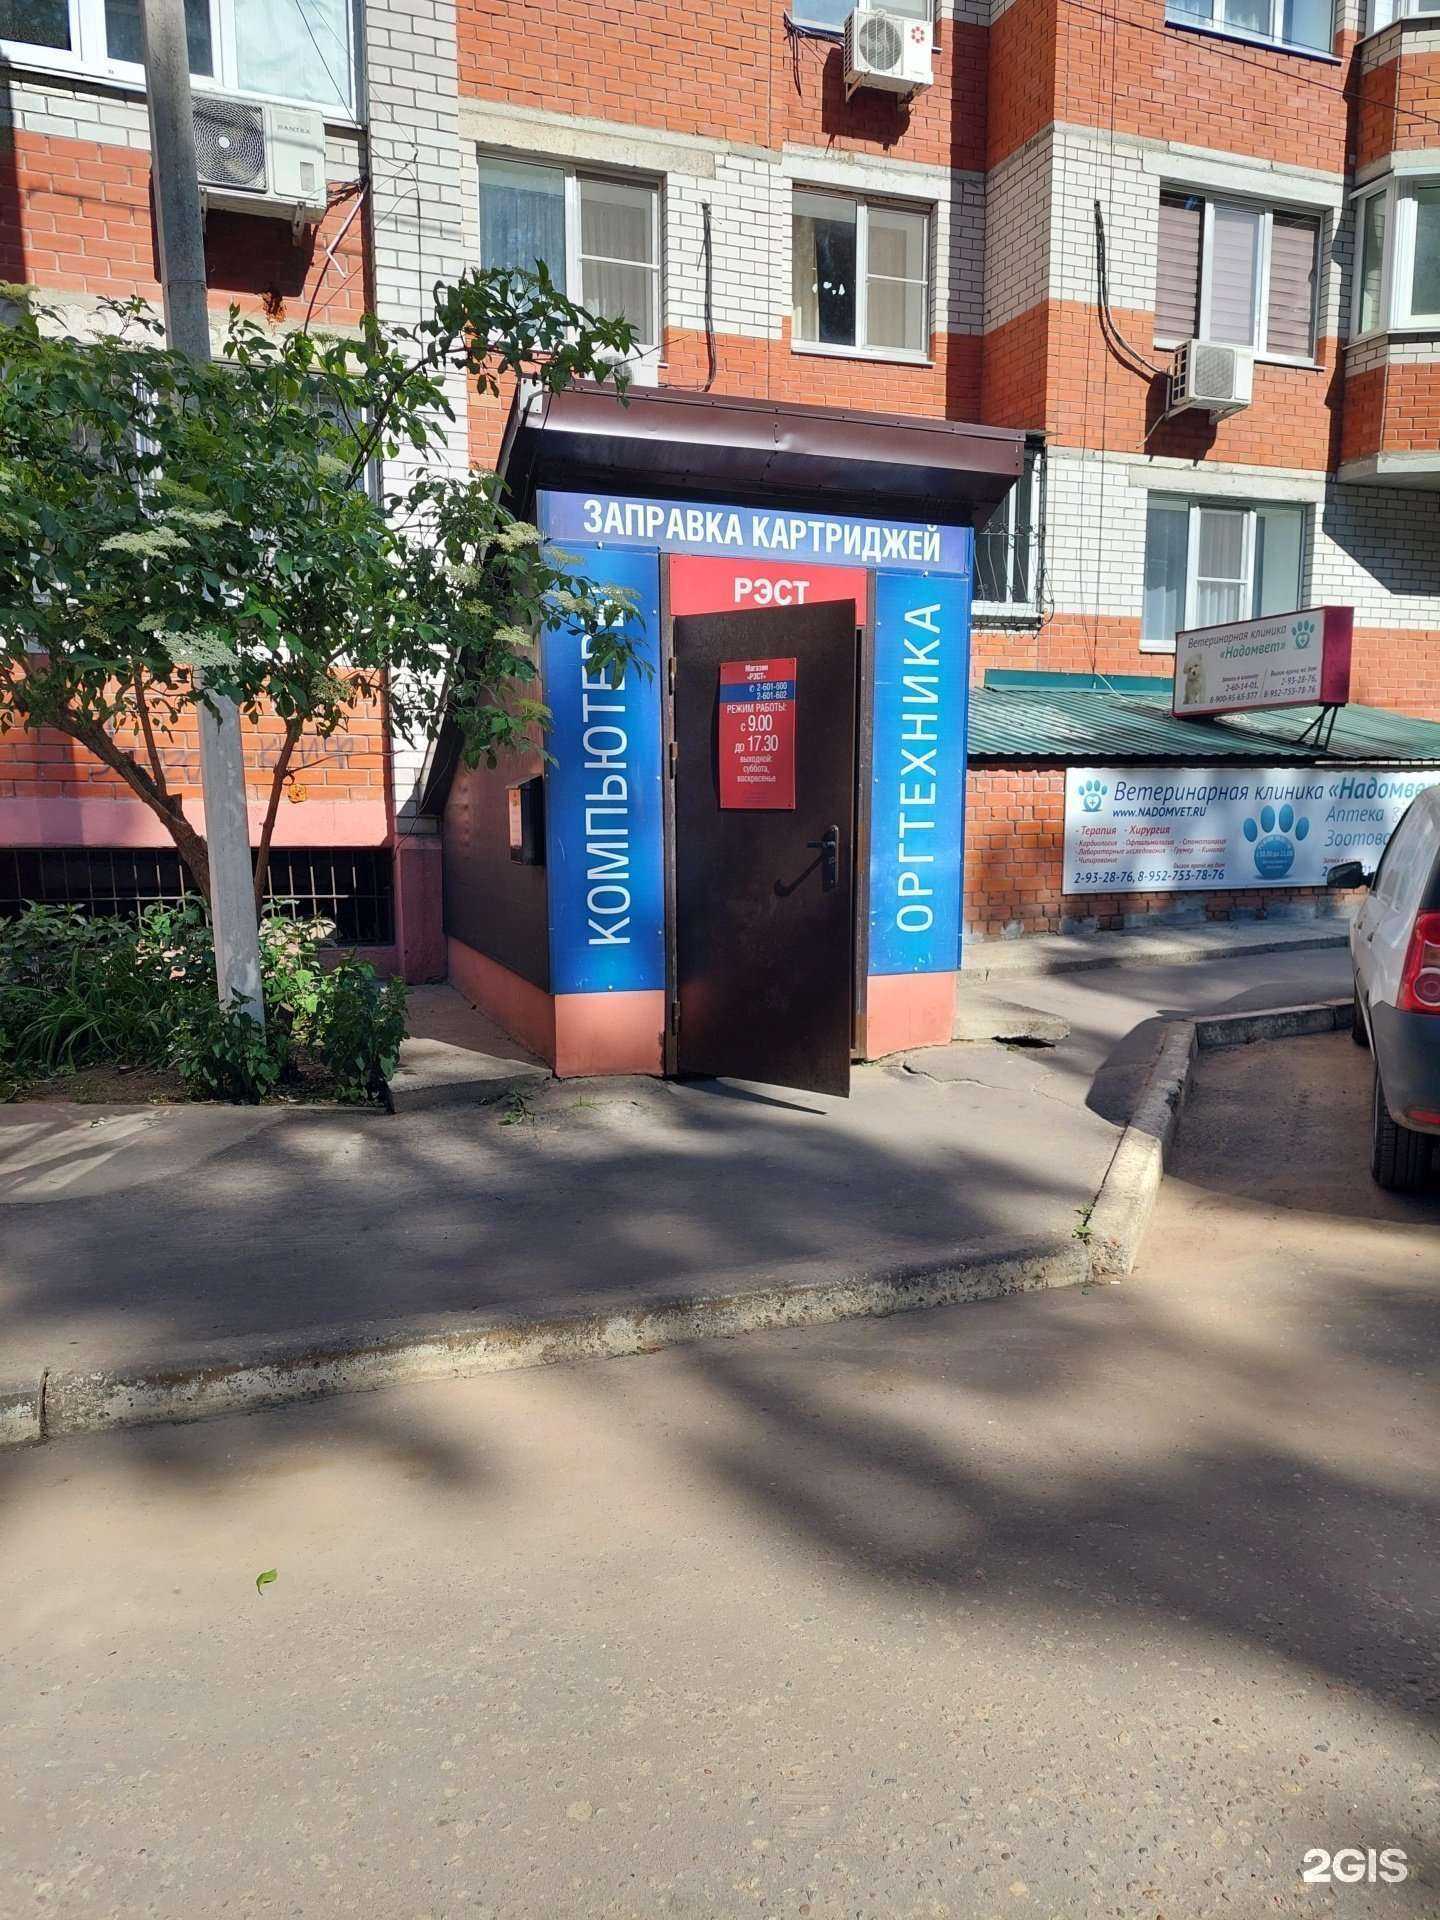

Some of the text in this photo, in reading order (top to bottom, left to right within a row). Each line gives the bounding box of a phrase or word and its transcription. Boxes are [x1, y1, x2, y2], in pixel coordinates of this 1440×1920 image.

[583, 499, 941, 564] ЗАПРАВКА КАРТРИДЖЕЙ
[734, 577, 811, 606] РЭСТ
[1187, 624, 1287, 649] Ветеринарная клиника
[1220, 641, 1286, 660] «Надомвет»
[744, 664, 769, 673] Магазин
[727, 704, 754, 714] РЕЖИМ
[740, 714, 773, 732] с 9.00
[734, 734, 779, 754] до 17.30
[742, 764, 770, 774] суббота,
[896, 603, 942, 933] ОРГТЕХНИКА
[737, 775, 777, 784] воскресенье
[1114, 775, 1430, 806] Ветеринарная клиника «Надомве
[1112, 806, 1207, 818] www.NADOMVET.RU
[1325, 806, 1385, 823] Аптека
[1081, 825, 1171, 836] Терапия Хирургия
[1073, 868, 1225, 884] 2-93-28-76, 8-952-753-78-76
